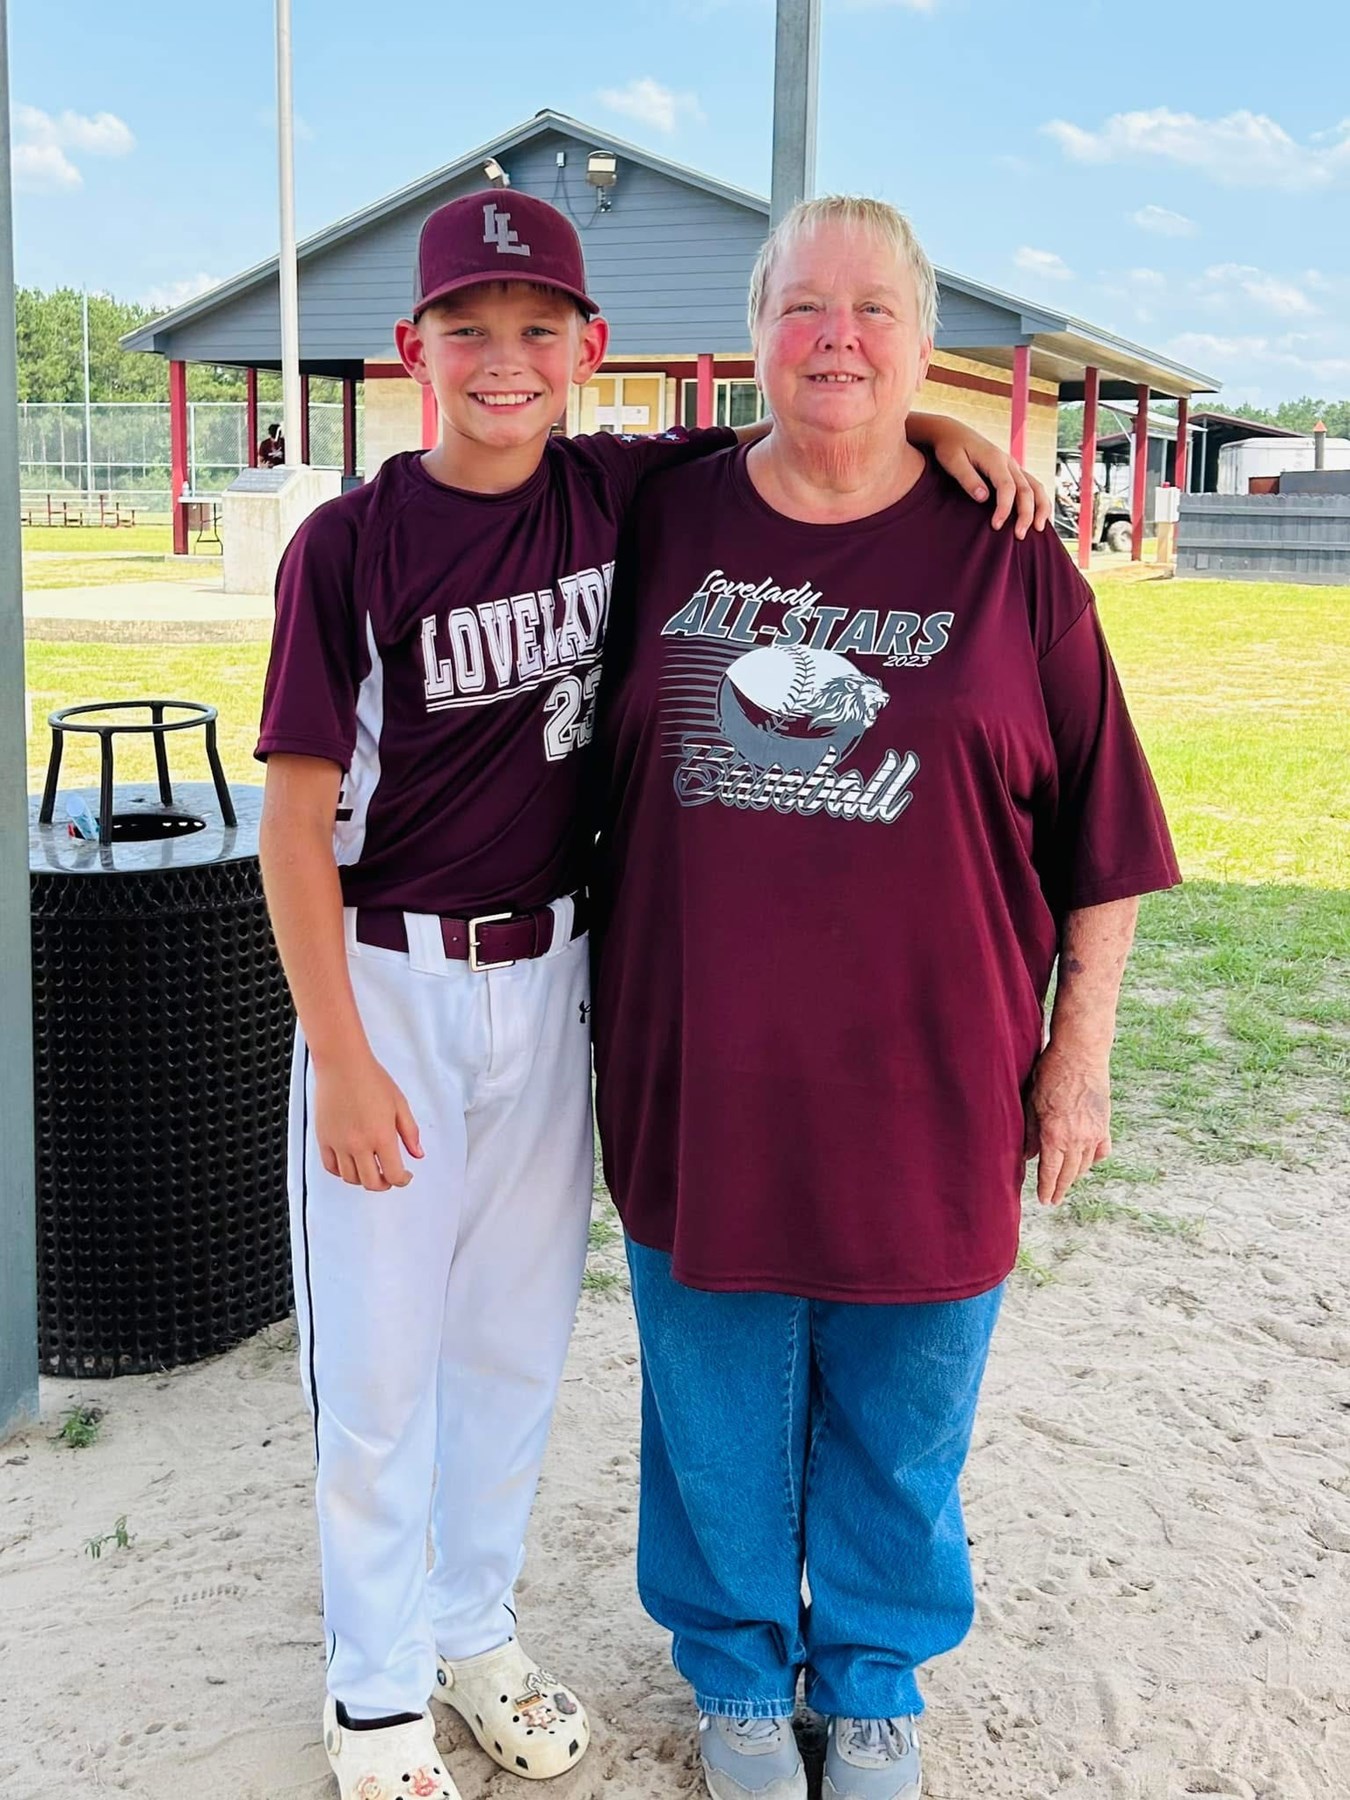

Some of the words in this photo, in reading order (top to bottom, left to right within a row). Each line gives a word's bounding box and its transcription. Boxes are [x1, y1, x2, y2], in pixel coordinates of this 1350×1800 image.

[483, 203, 531, 256] LL
[694, 569, 823, 617] Lovelady
[660, 592, 955, 656] ALL-STARS
[882, 655, 932, 668] 2023
[673, 731, 921, 824] Baseball
